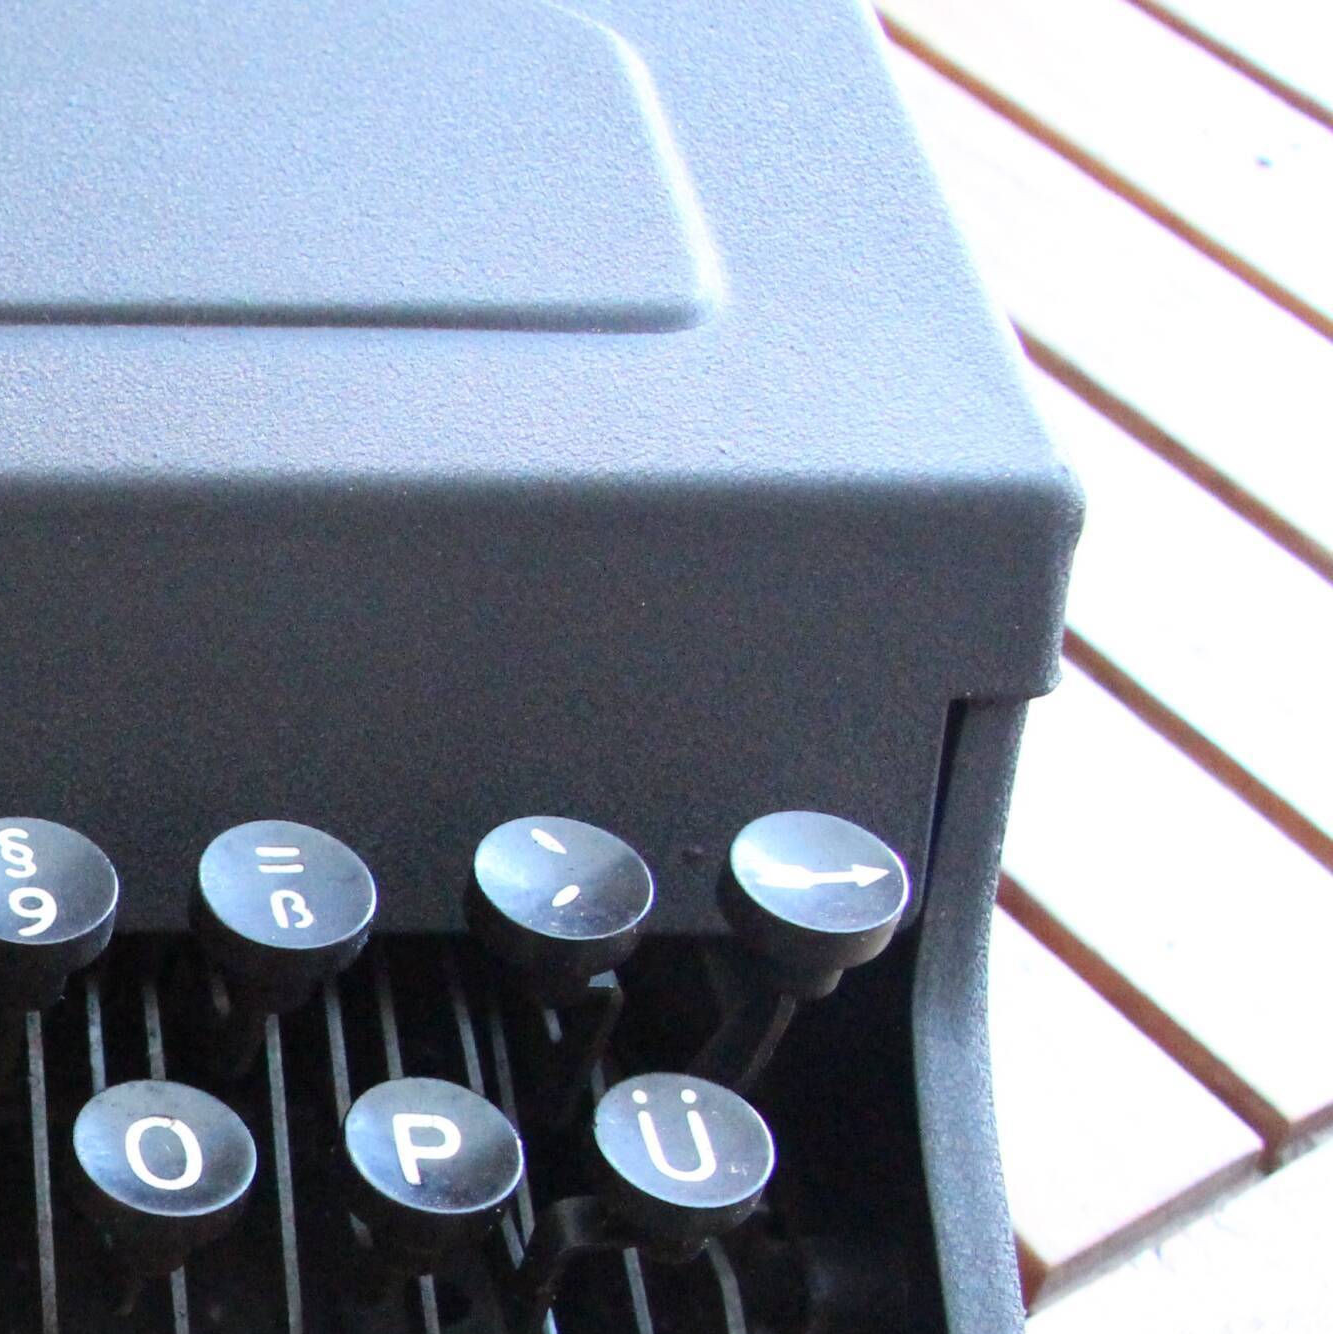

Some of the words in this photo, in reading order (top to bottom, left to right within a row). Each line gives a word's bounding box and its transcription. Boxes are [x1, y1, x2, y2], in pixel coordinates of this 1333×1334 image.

[255, 845, 304, 874] =
[8, 886, 59, 938] 9
[125, 1115, 204, 1192] O
[393, 1112, 462, 1186] P
[632, 1088, 718, 1183] Ü
